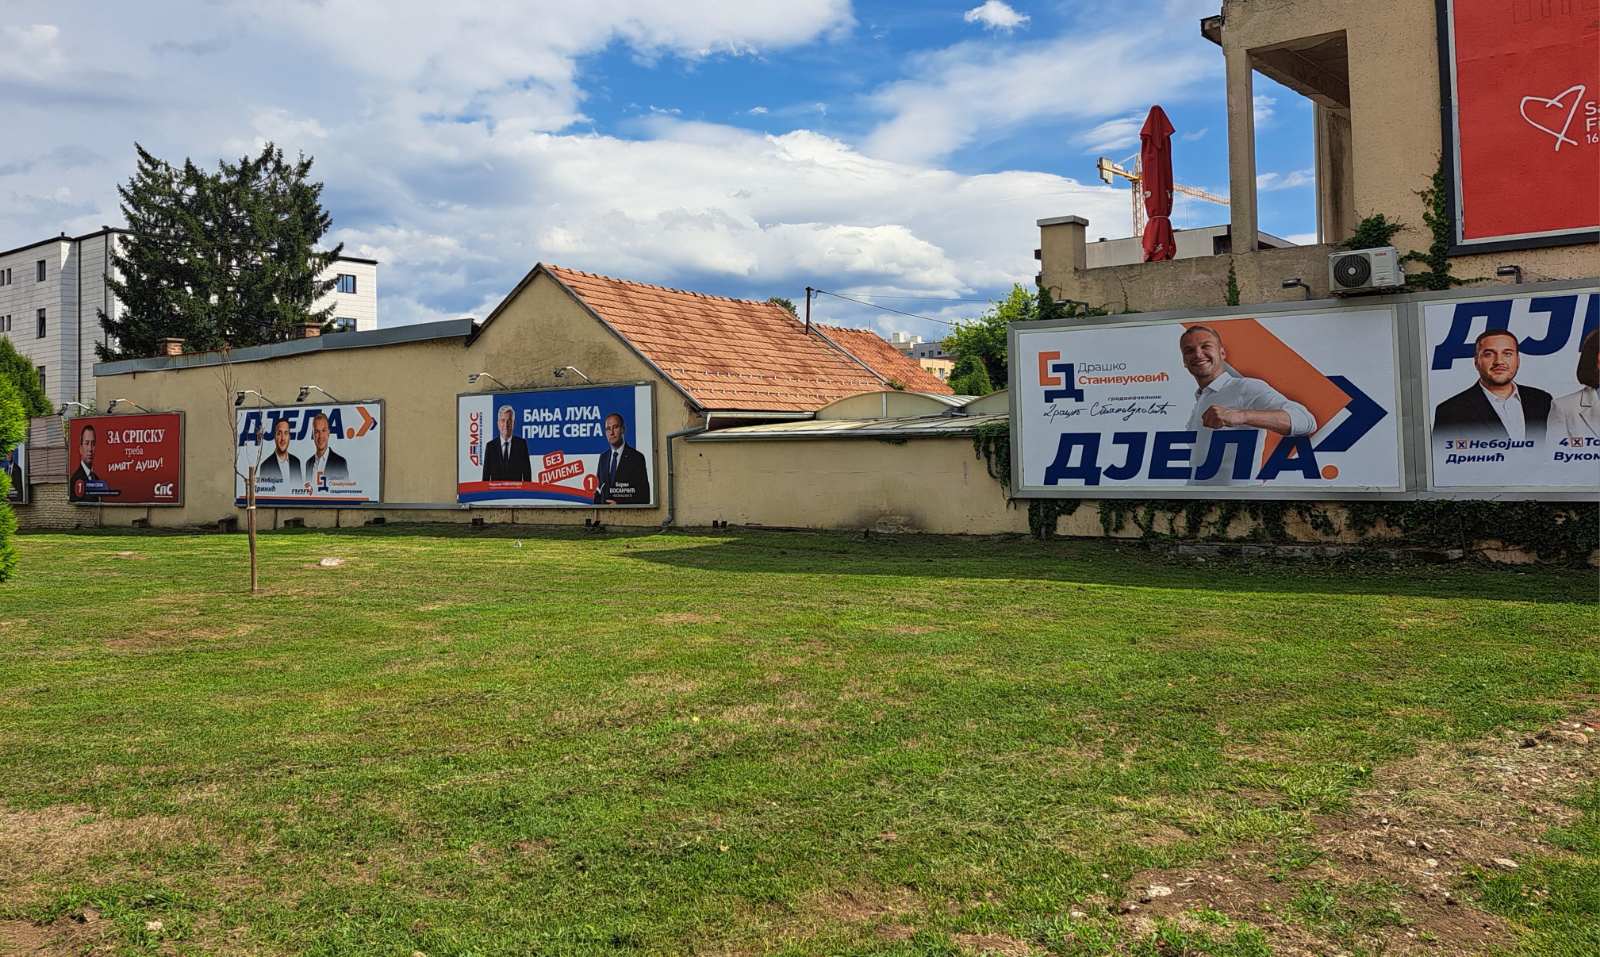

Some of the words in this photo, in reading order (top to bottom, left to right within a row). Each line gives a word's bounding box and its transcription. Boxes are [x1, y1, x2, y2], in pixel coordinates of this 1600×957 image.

[1585, 101, 1600, 116] S
[1586, 133, 1599, 144] 16
[1078, 362, 1127, 374] Драшко
[1078, 371, 1169, 386] Станивуковић
[523, 408, 563, 422] БАЊА
[564, 405, 601, 420] ЛУКА
[107, 430, 121, 444] ЗА
[122, 429, 165, 444] СРПСКУ
[522, 424, 561, 439] ПРИЈЕ
[563, 422, 603, 437] СВЕГА
[1445, 440, 1454, 450] 3
[1469, 438, 1535, 451] Небојша
[1559, 437, 1569, 447] 4
[125, 445, 144, 456] треба
[135, 457, 163, 472] душу!
[545, 455, 562, 467] БЕЗ
[1446, 451, 1505, 465] Дринић
[541, 466, 581, 485] ДИЛЕМЕ
